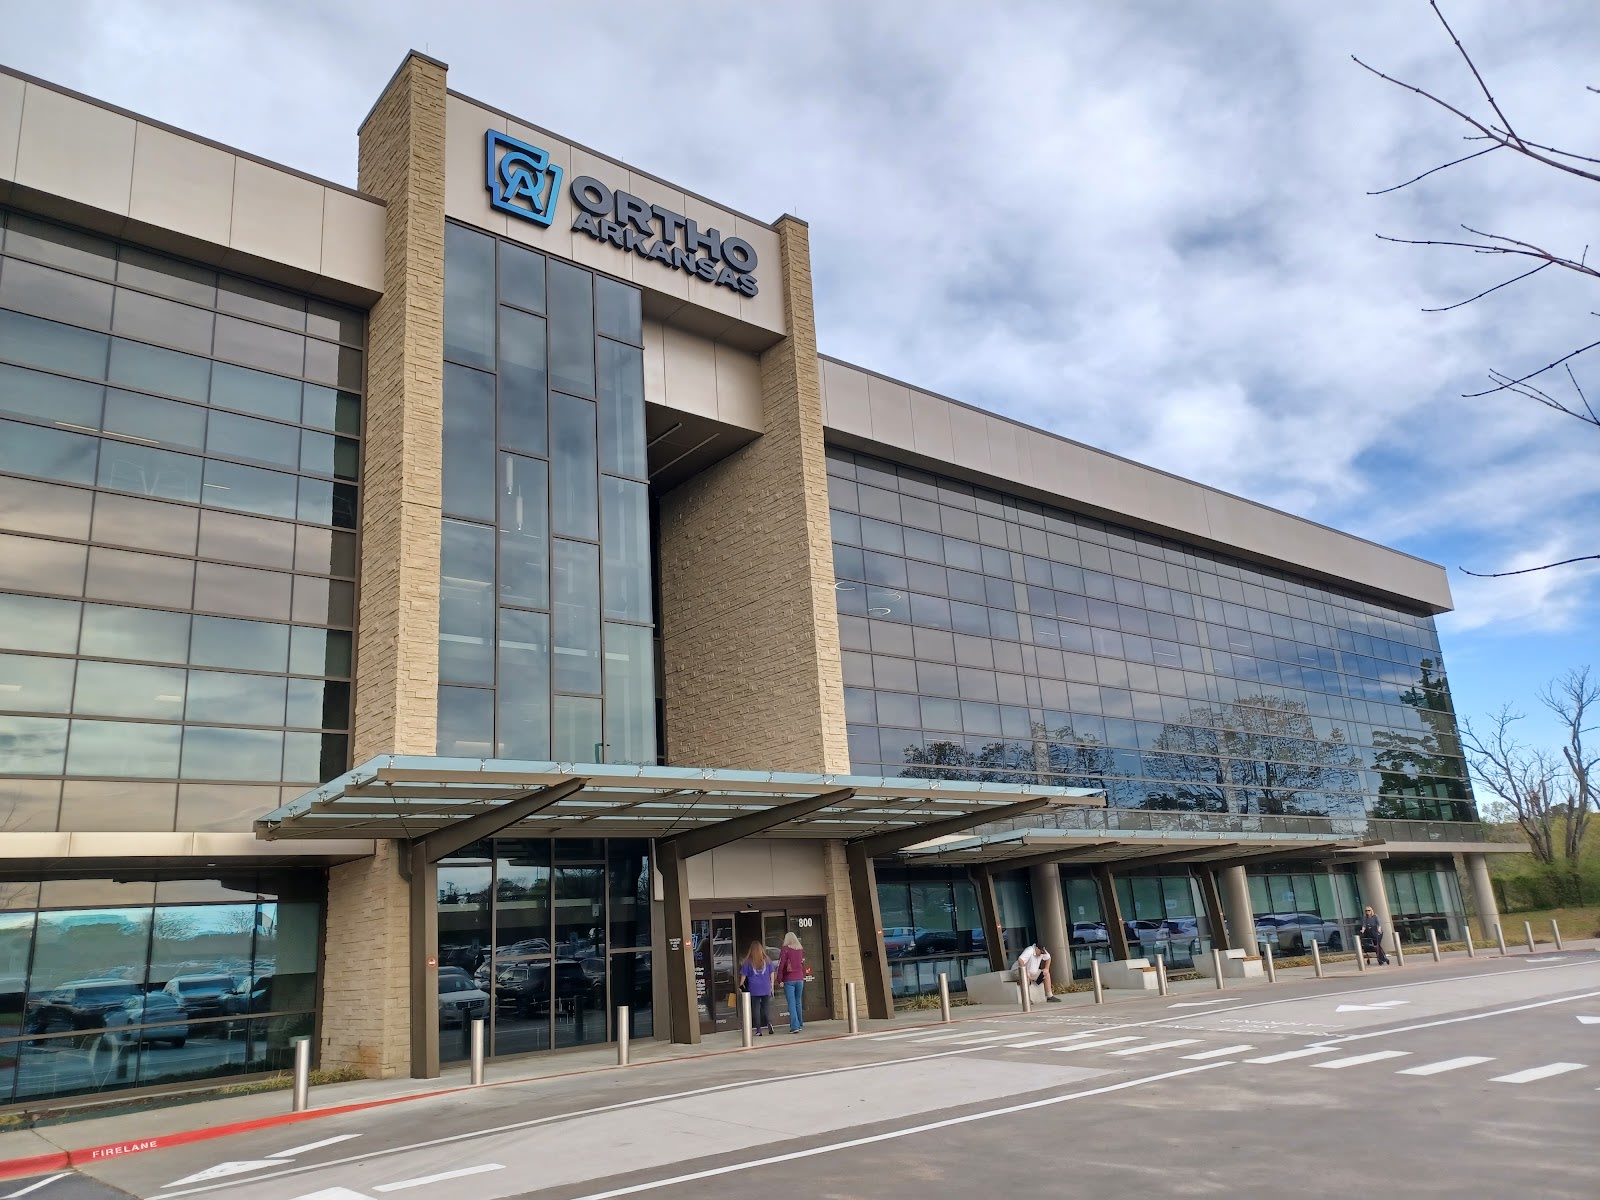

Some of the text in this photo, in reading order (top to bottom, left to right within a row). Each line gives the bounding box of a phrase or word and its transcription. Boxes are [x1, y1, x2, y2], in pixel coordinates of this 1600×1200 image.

[570, 176, 758, 274] ORTHO
[571, 211, 759, 297] ARKANSAS
[798, 917, 813, 928] 800
